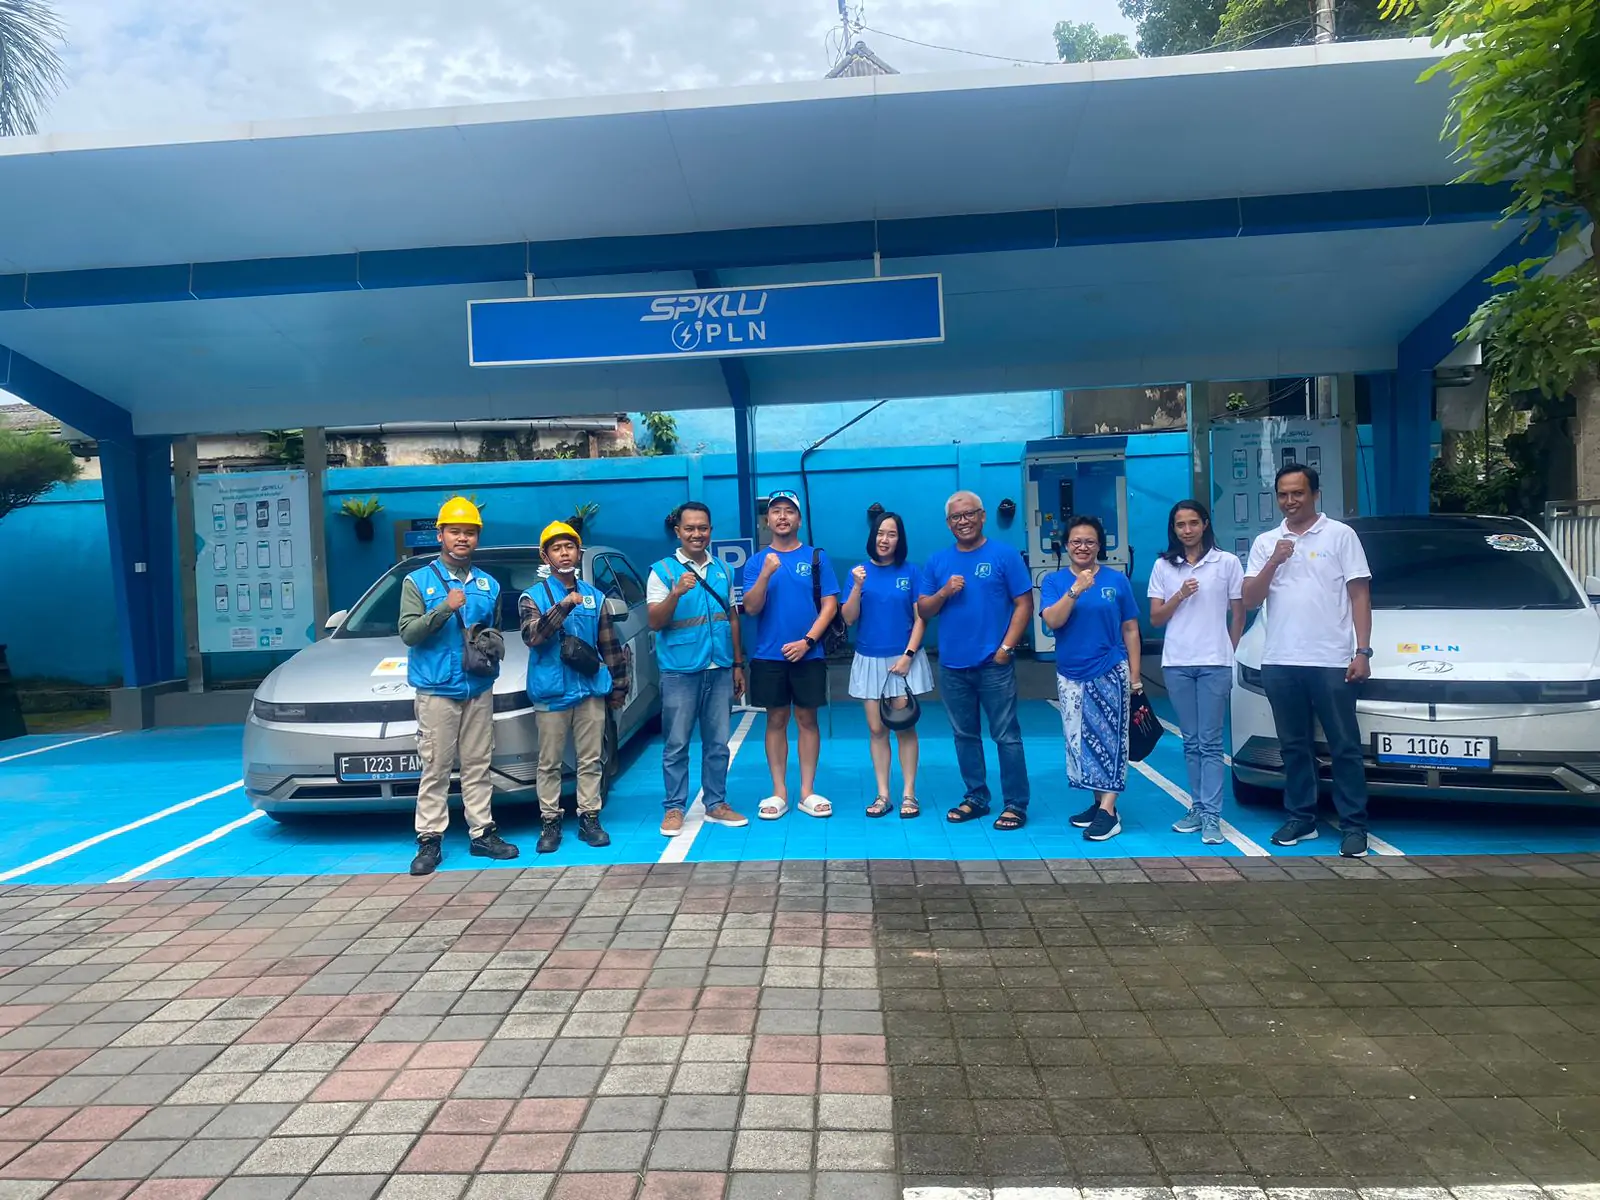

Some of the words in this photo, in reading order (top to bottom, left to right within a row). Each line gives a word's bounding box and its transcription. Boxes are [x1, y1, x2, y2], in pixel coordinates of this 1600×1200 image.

[640, 291, 767, 321] SPKLU
[706, 321, 766, 343] PLN
[718, 546, 747, 569] P
[1421, 644, 1460, 652] PLN
[1383, 737, 1392, 753] B
[1407, 738, 1449, 756] 1106
[1463, 740, 1483, 757] IF
[341, 757, 349, 773] F
[363, 757, 393, 773] 1223
